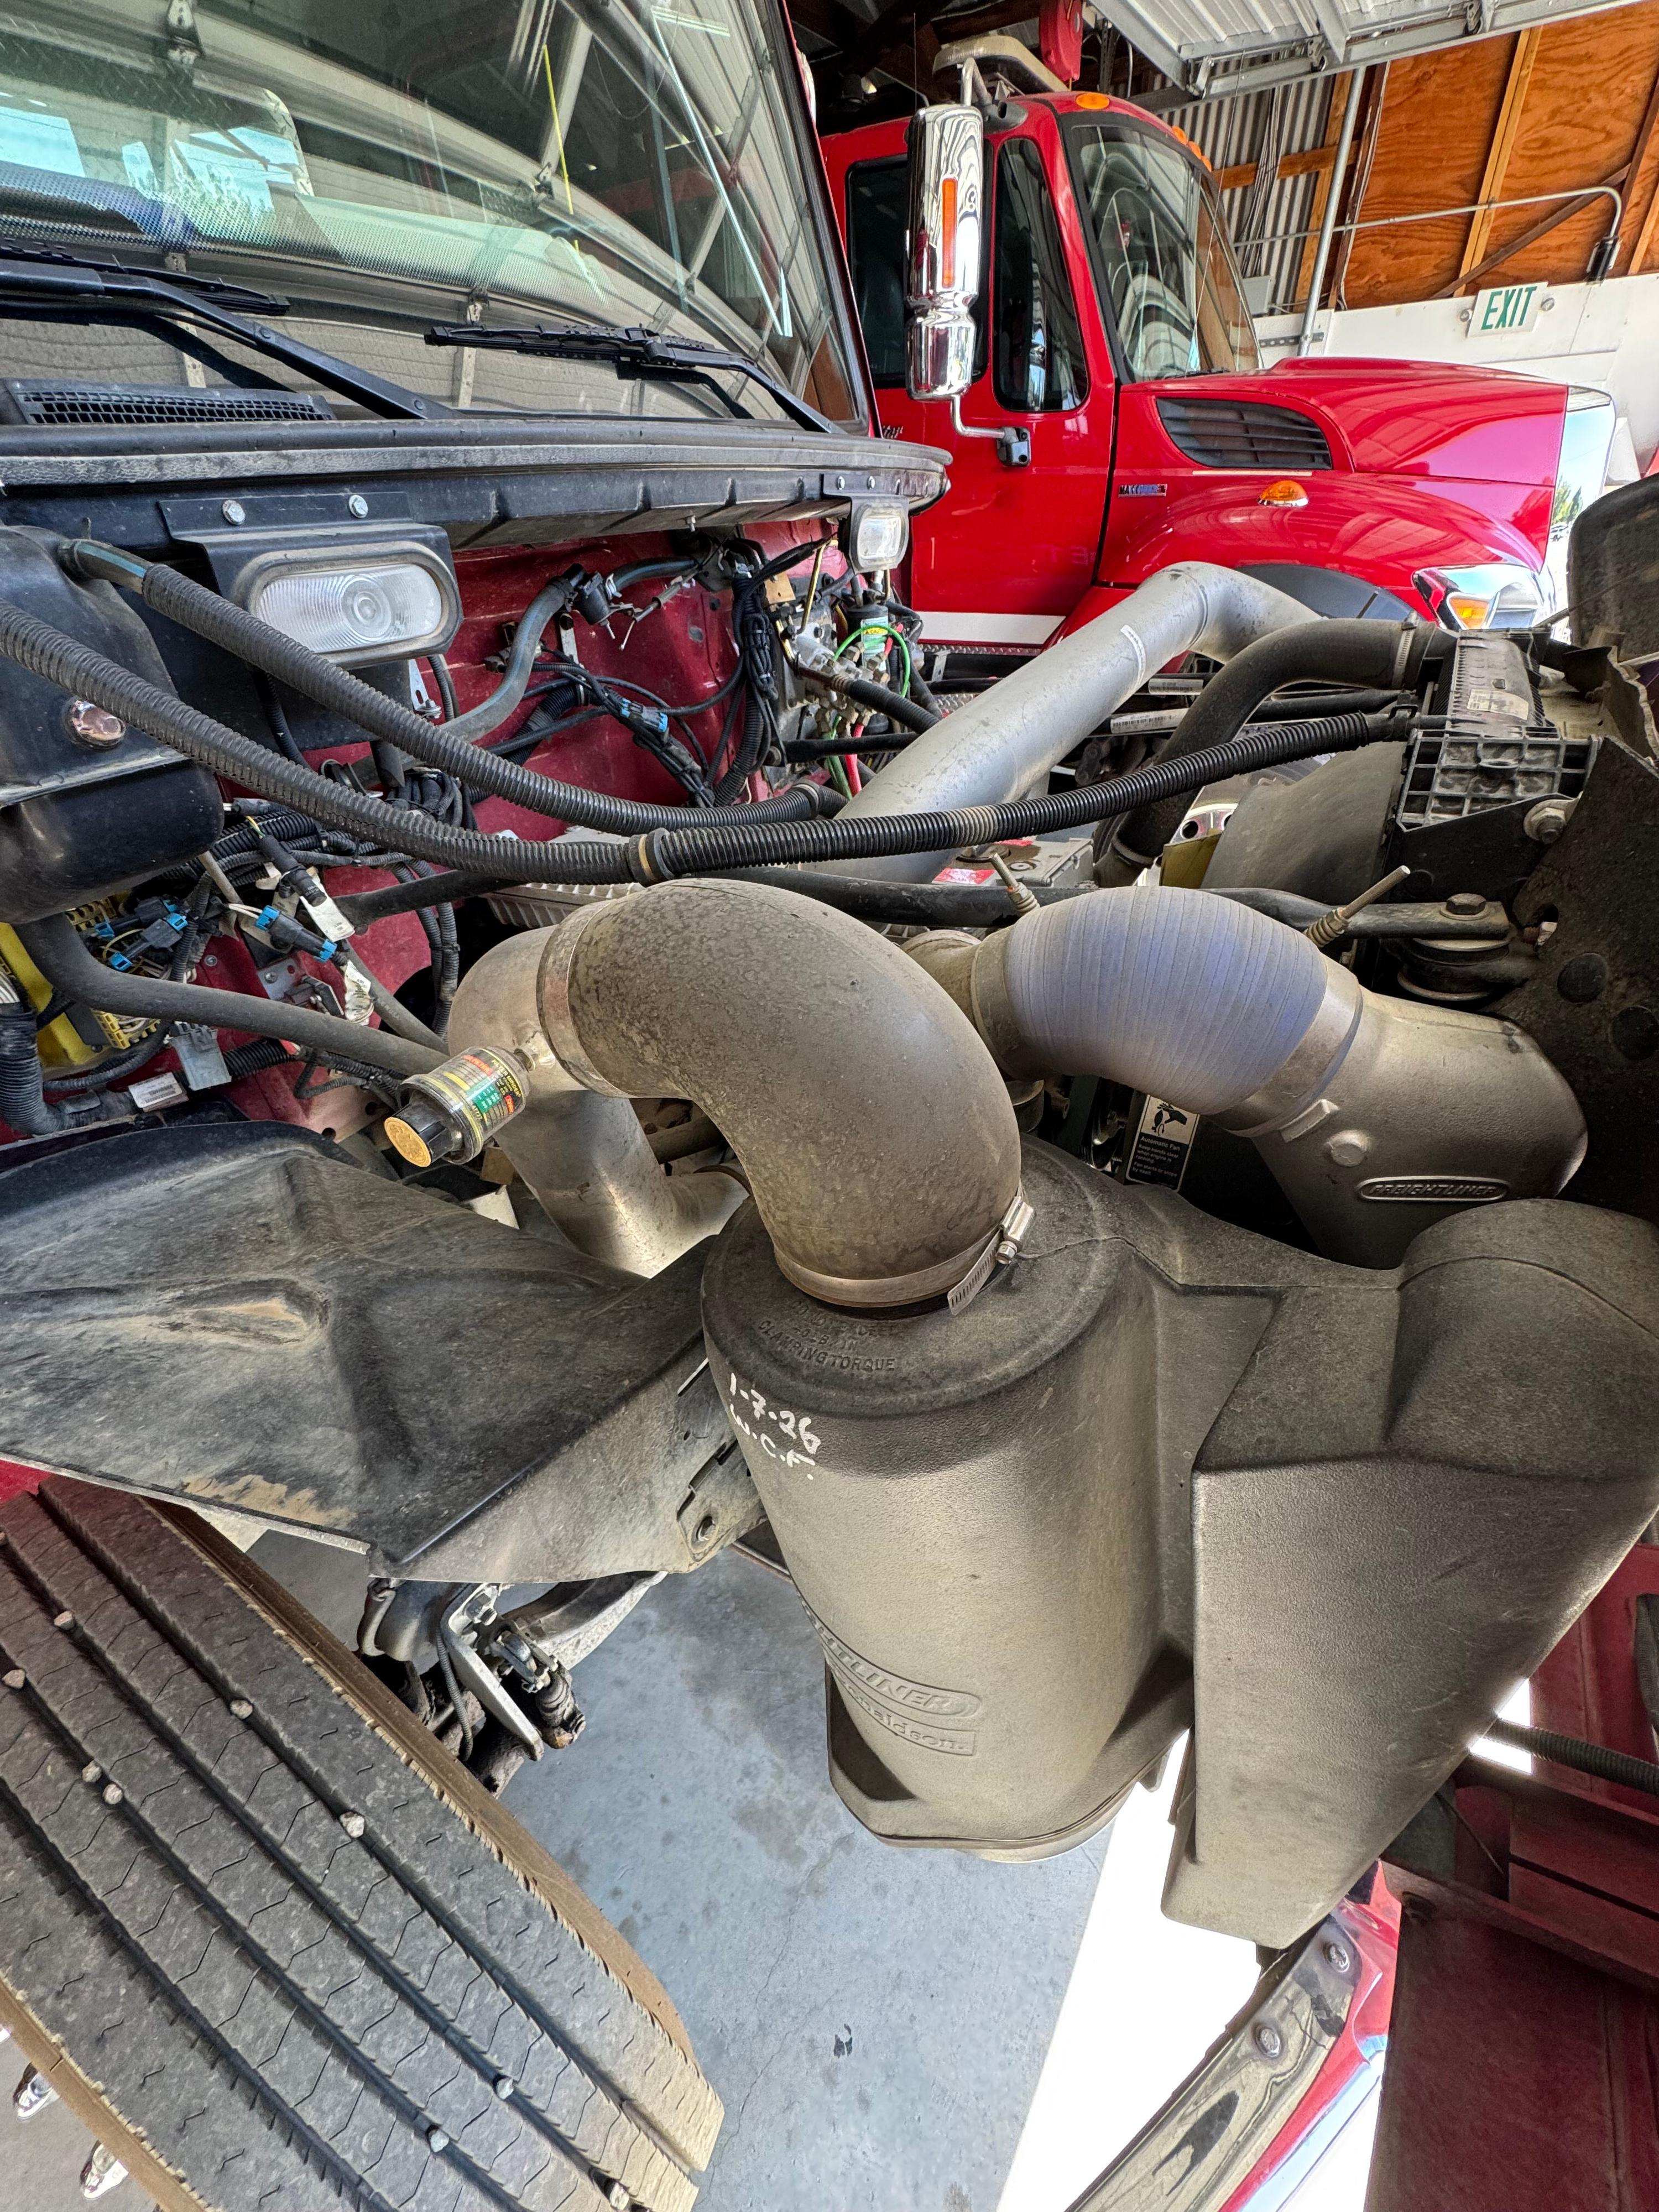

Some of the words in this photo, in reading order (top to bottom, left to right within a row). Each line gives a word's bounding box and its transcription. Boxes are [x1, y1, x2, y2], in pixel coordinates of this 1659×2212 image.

[1481, 286, 1537, 330] EXIT
[492, 1059, 508, 1076] FILTER
[1140, 1136, 1168, 1148] Automatic
[1169, 1144, 1181, 1152] Fan
[1369, 1184, 1496, 1196] FREIGHTLINER
[759, 1319, 828, 1364] CLAMPING
[829, 1354, 896, 1372] TORQUE
[729, 1373, 821, 1455] 1-7-26
